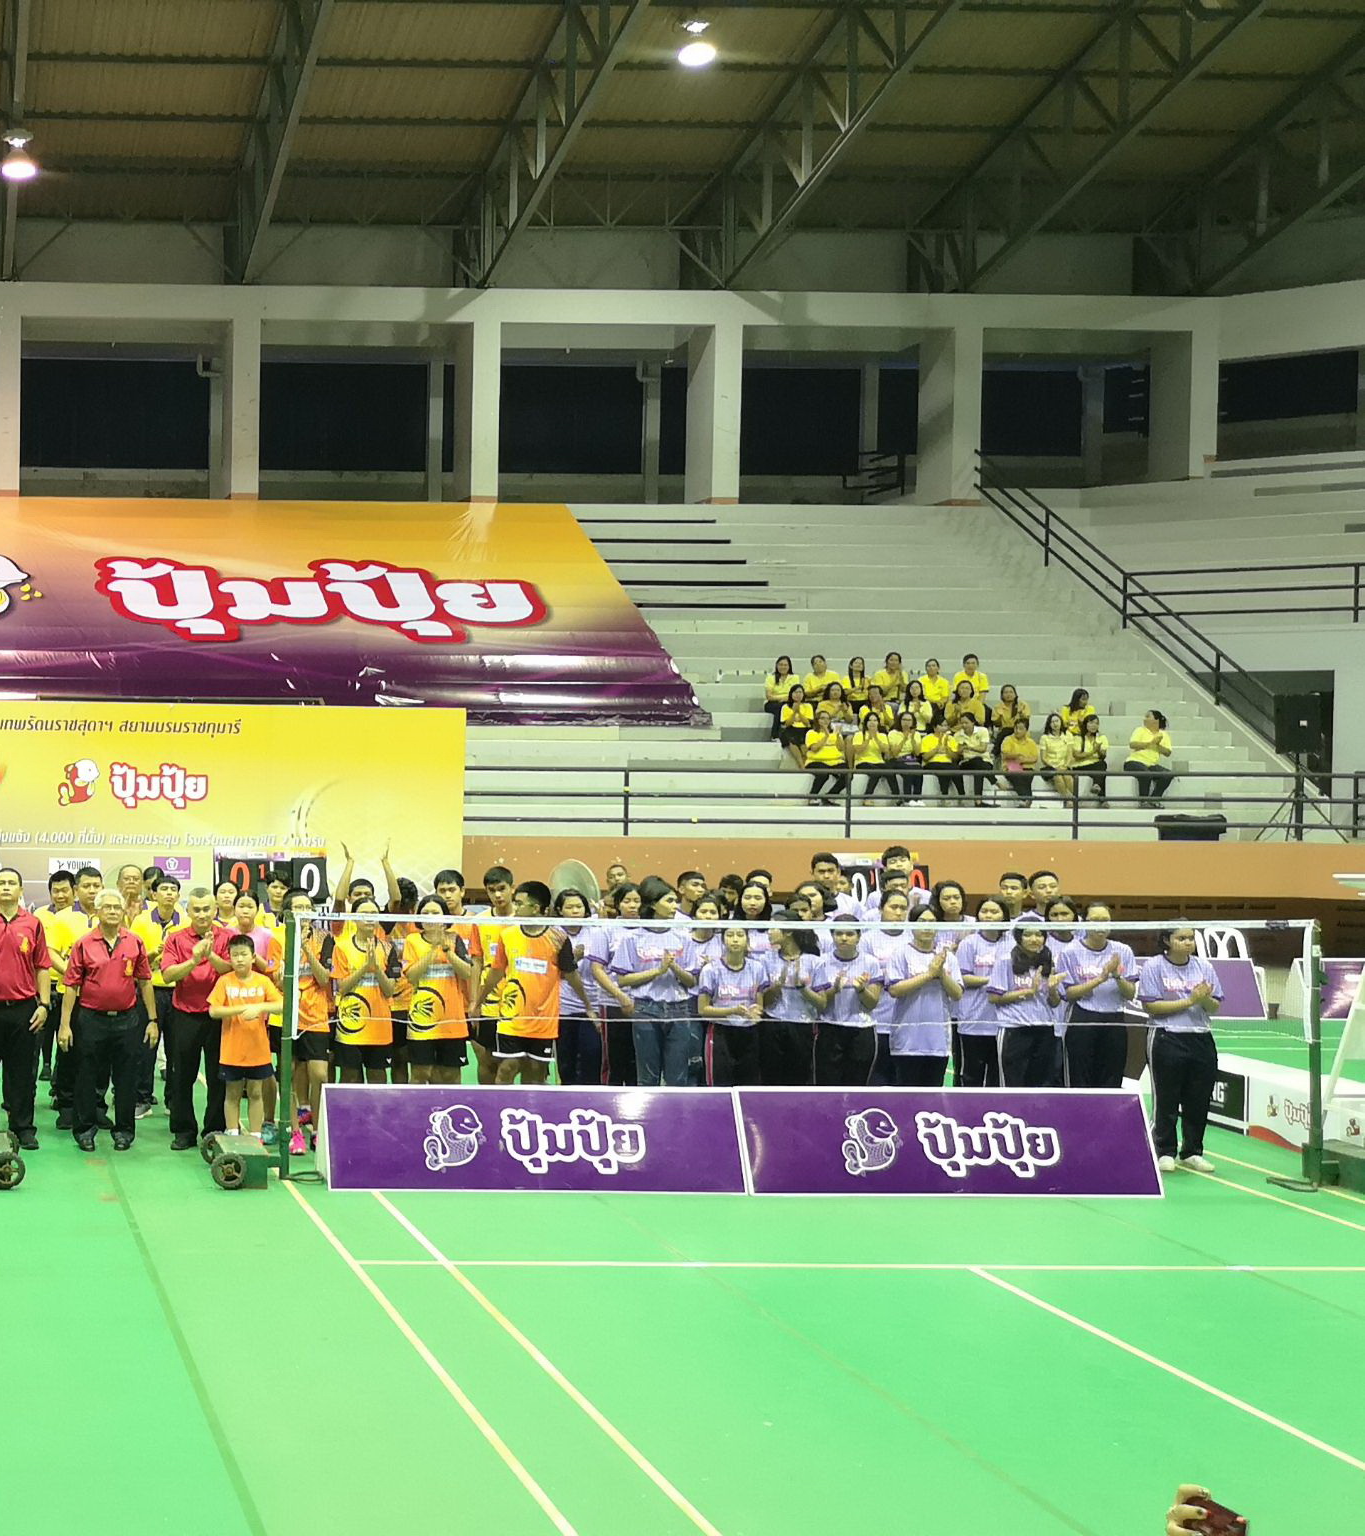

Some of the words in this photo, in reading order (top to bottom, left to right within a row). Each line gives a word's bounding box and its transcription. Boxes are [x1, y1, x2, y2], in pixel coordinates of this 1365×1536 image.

[95, 557, 547, 643] ปุ้มปุ้ย
[119, 718, 242, 738] สยามบรมราชกุมารี
[109, 762, 208, 809] ปุ้มปุ้ย
[258, 863, 266, 880] 1
[300, 862, 321, 898] 0
[500, 1108, 646, 1174] ปุ้มปุ้ย
[915, 1111, 1061, 1178] ปุ้มปุ้ย
